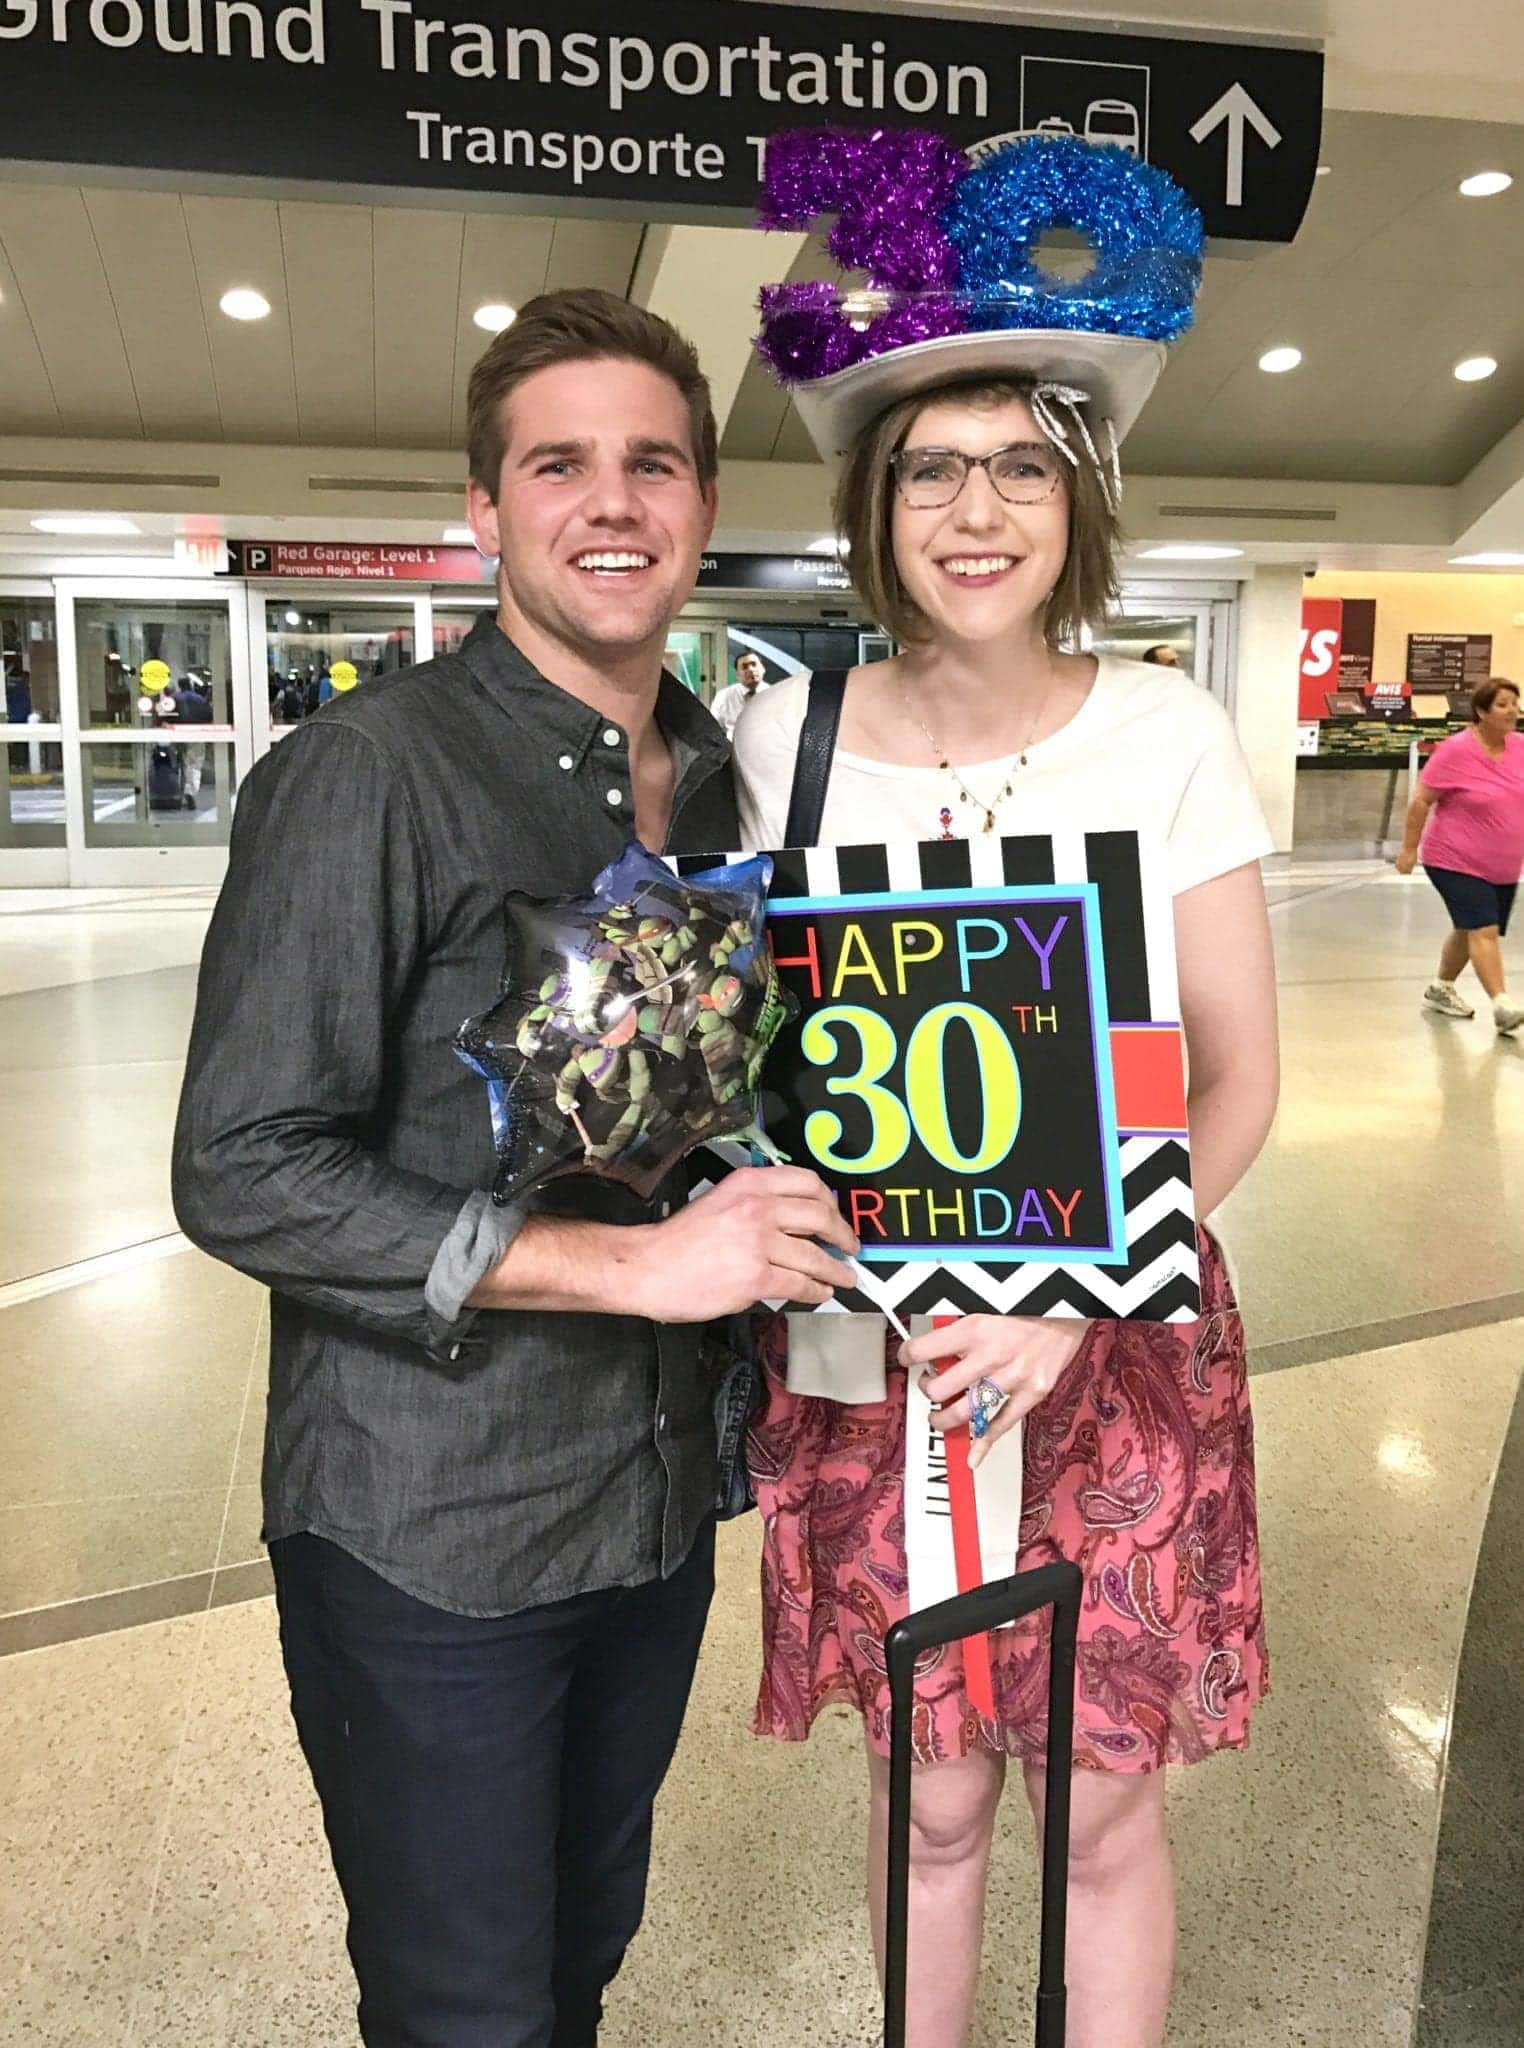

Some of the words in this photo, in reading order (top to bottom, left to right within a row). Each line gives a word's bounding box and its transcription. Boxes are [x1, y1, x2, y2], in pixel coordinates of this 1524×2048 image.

[360, 0, 988, 117] Transportation
[406, 111, 726, 184] Transporte
[278, 545, 308, 560] Red
[313, 547, 376, 565] Garage:
[380, 547, 422, 563] Level
[427, 550, 436, 564] 1
[278, 563, 324, 576] Parqueo
[356, 565, 385, 577] Nivel
[388, 566, 395, 577] 1
[1374, 683, 1403, 696] AVIS
[765, 915, 1069, 998] HAPPY
[832, 1187, 1083, 1238] RTHDAY
